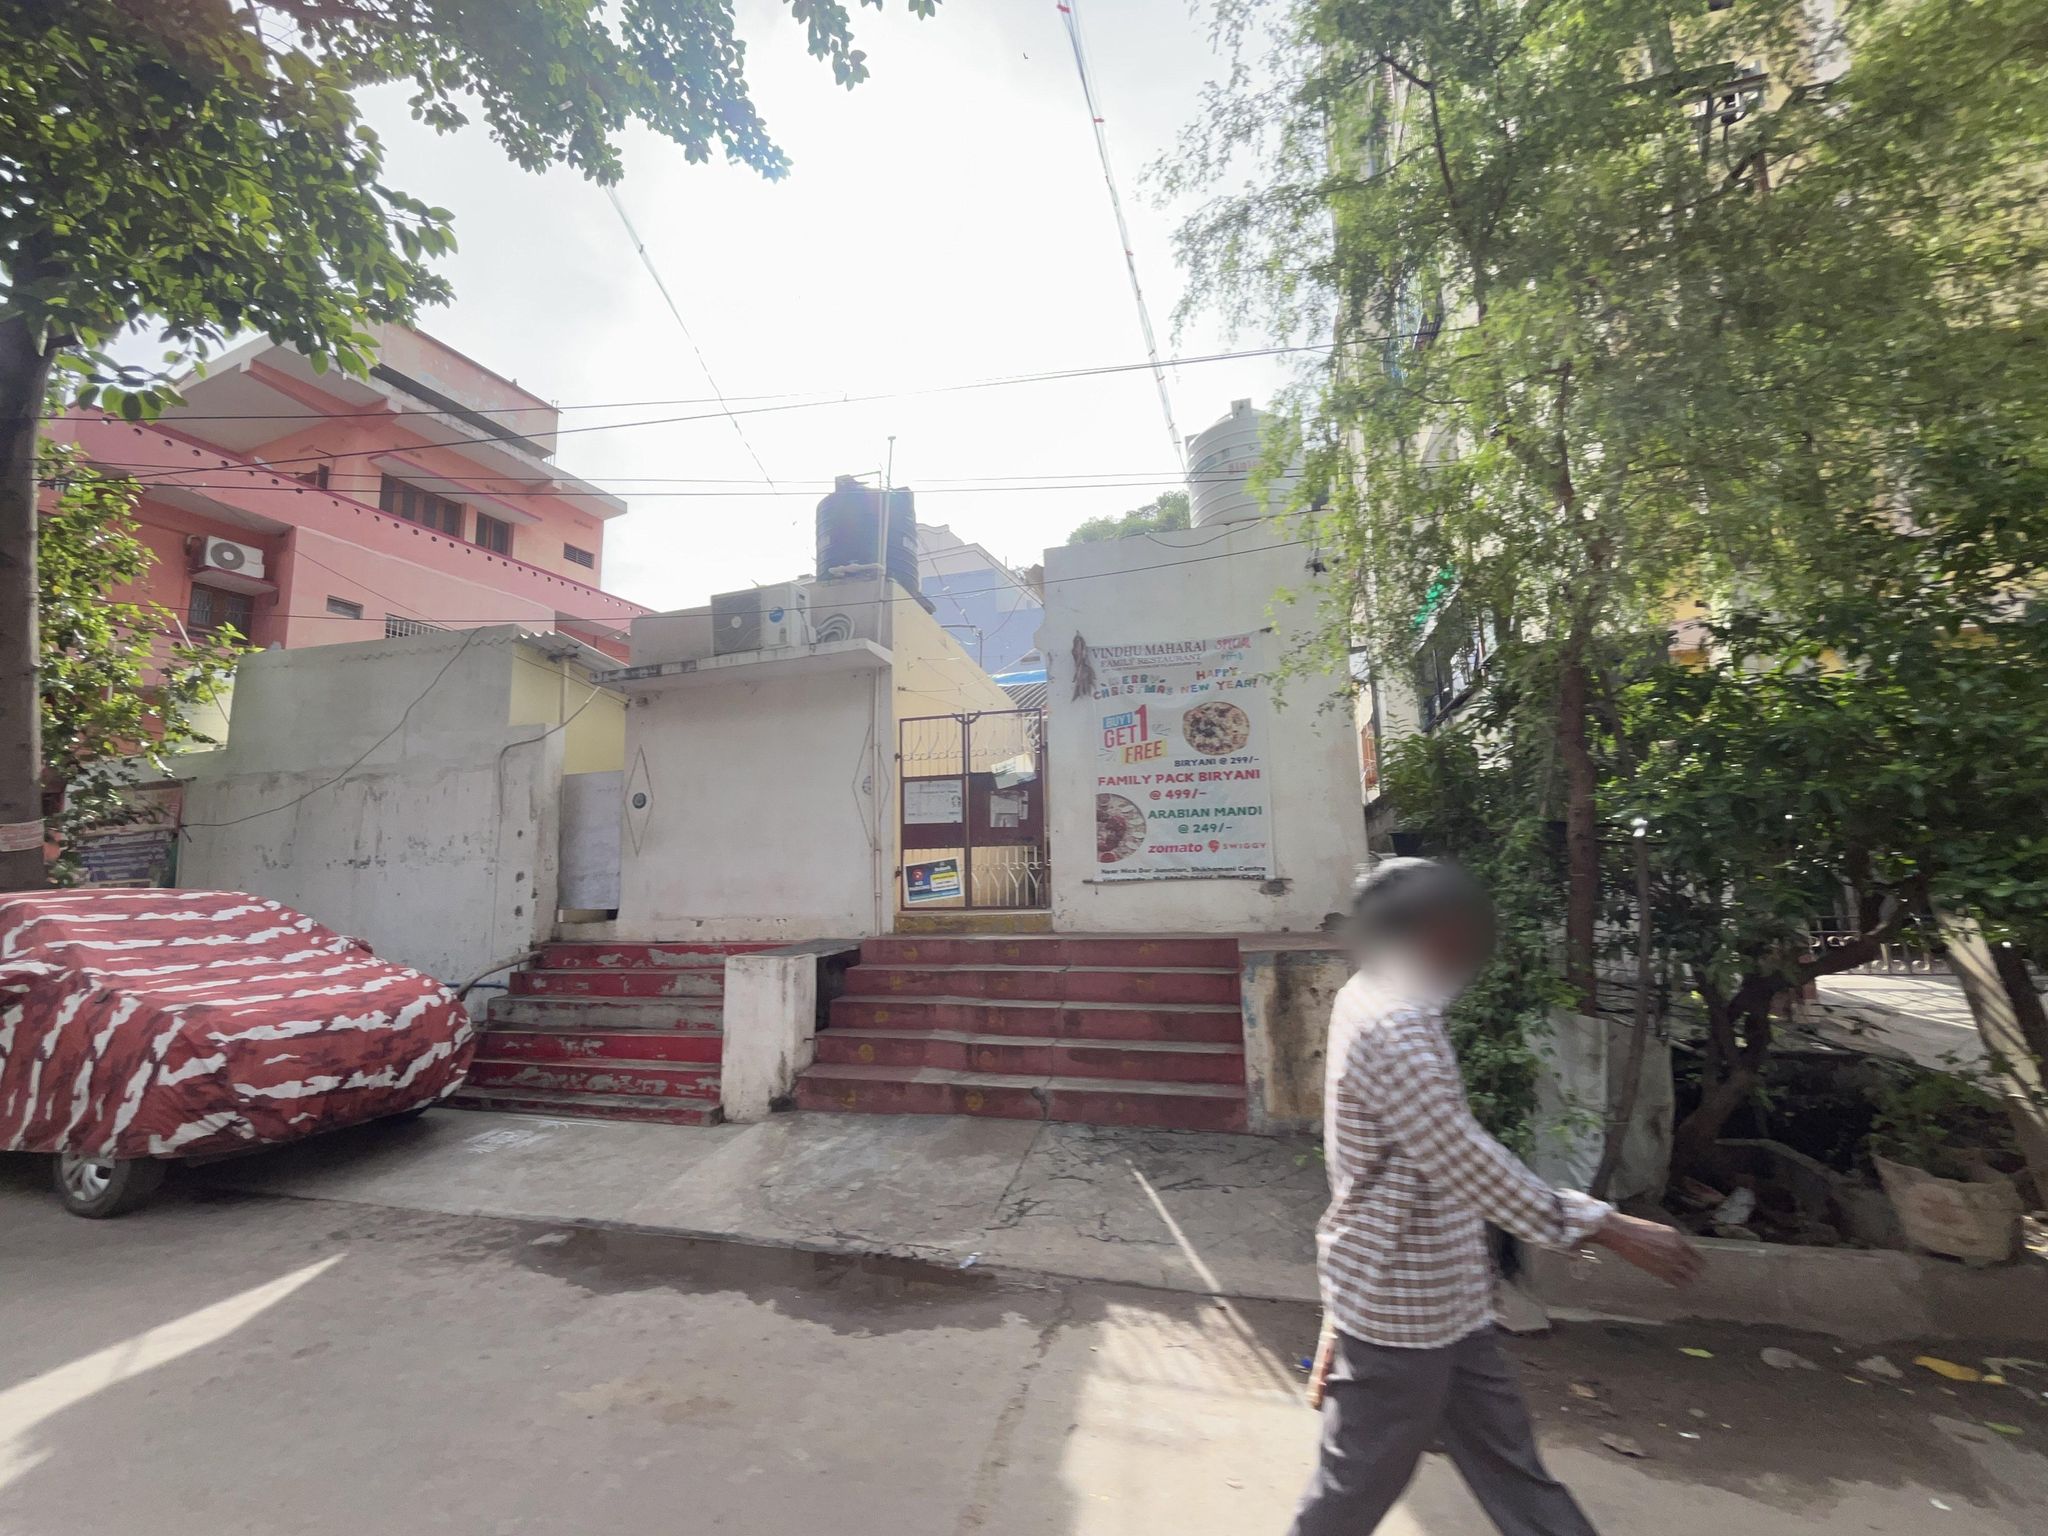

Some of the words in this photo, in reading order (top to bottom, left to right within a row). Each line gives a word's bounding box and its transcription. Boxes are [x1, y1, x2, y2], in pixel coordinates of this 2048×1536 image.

[1092, 645, 1142, 659] VINDHU
[1137, 653, 1201, 665] RESTAURANT
[1195, 666, 1239, 680] HAPPY
[1093, 684, 1174, 700] CHRISTMAS
[1180, 683, 1210, 693] NEW
[1104, 725, 1138, 748] GET
[1134, 704, 1148, 741] 1
[1124, 740, 1163, 764] FREE
[1174, 758, 1216, 767] BIRYANI
[1230, 755, 1260, 765] 299/-
[1097, 774, 1151, 786] FAMILY
[1155, 772, 1194, 784] PACK
[1198, 769, 1260, 782] BIRYANI
[1149, 790, 1161, 801] @
[1165, 788, 1207, 800] 499/-
[1147, 807, 1210, 819] ARABIAN
[1214, 805, 1263, 817] MANDI
[1177, 824, 1189, 834] @
[1192, 822, 1233, 834] 249/-
[1147, 843, 1204, 854] zomato
